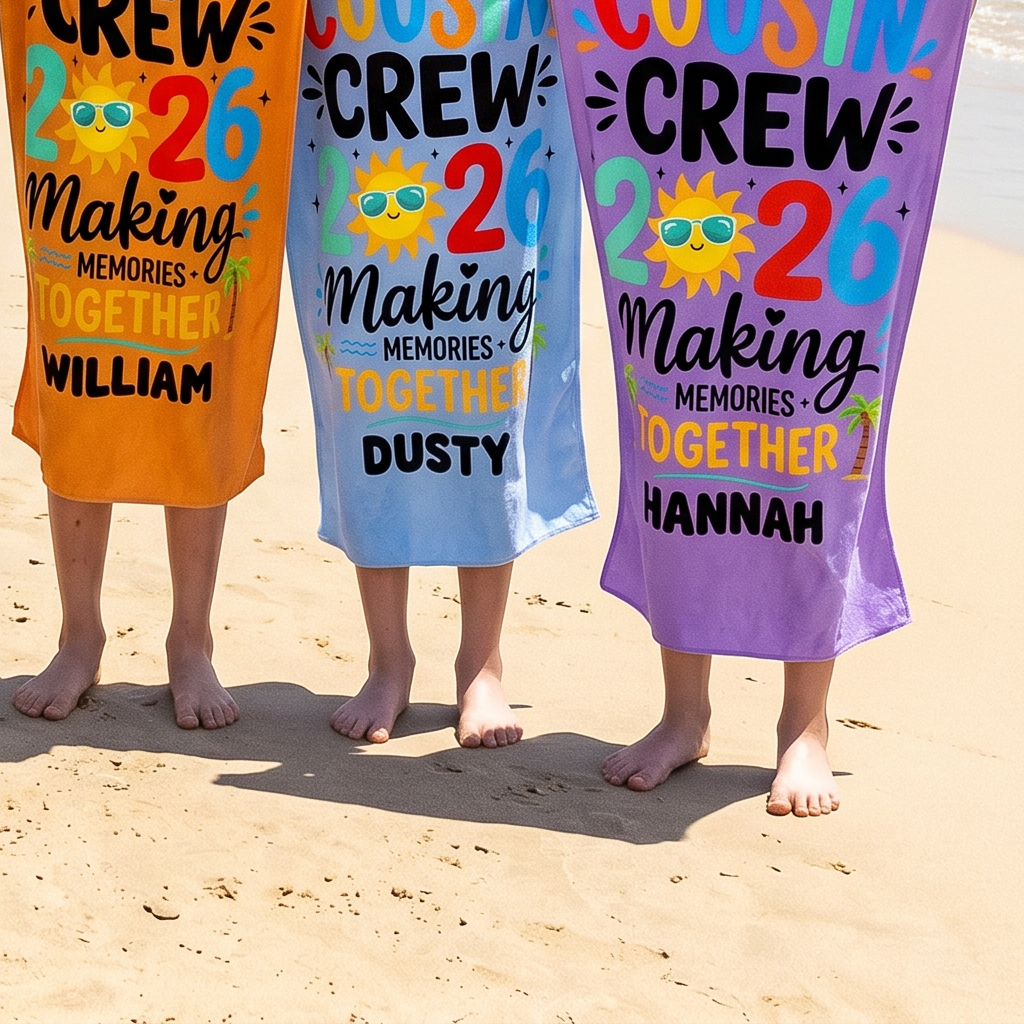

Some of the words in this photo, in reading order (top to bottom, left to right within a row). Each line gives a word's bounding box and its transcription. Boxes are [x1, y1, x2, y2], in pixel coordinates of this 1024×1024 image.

[324, 44, 539, 141] CREW
[625, 56, 897, 173] CREW
[25, 171, 244, 284] Making
[77, 251, 186, 288] MEMORIES
[35, 273, 221, 340] TOGETHER
[324, 253, 537, 353] Making
[41, 344, 212, 404] WILLIAM
[384, 335, 493, 361] MEMORIES
[619, 292, 879, 415] Making
[334, 359, 526, 413] TOGETHER
[675, 383, 795, 418] MEMORIES
[362, 432, 510, 476] DUSTY
[639, 402, 838, 476] TOGETHER
[643, 480, 824, 545] HANNAH
